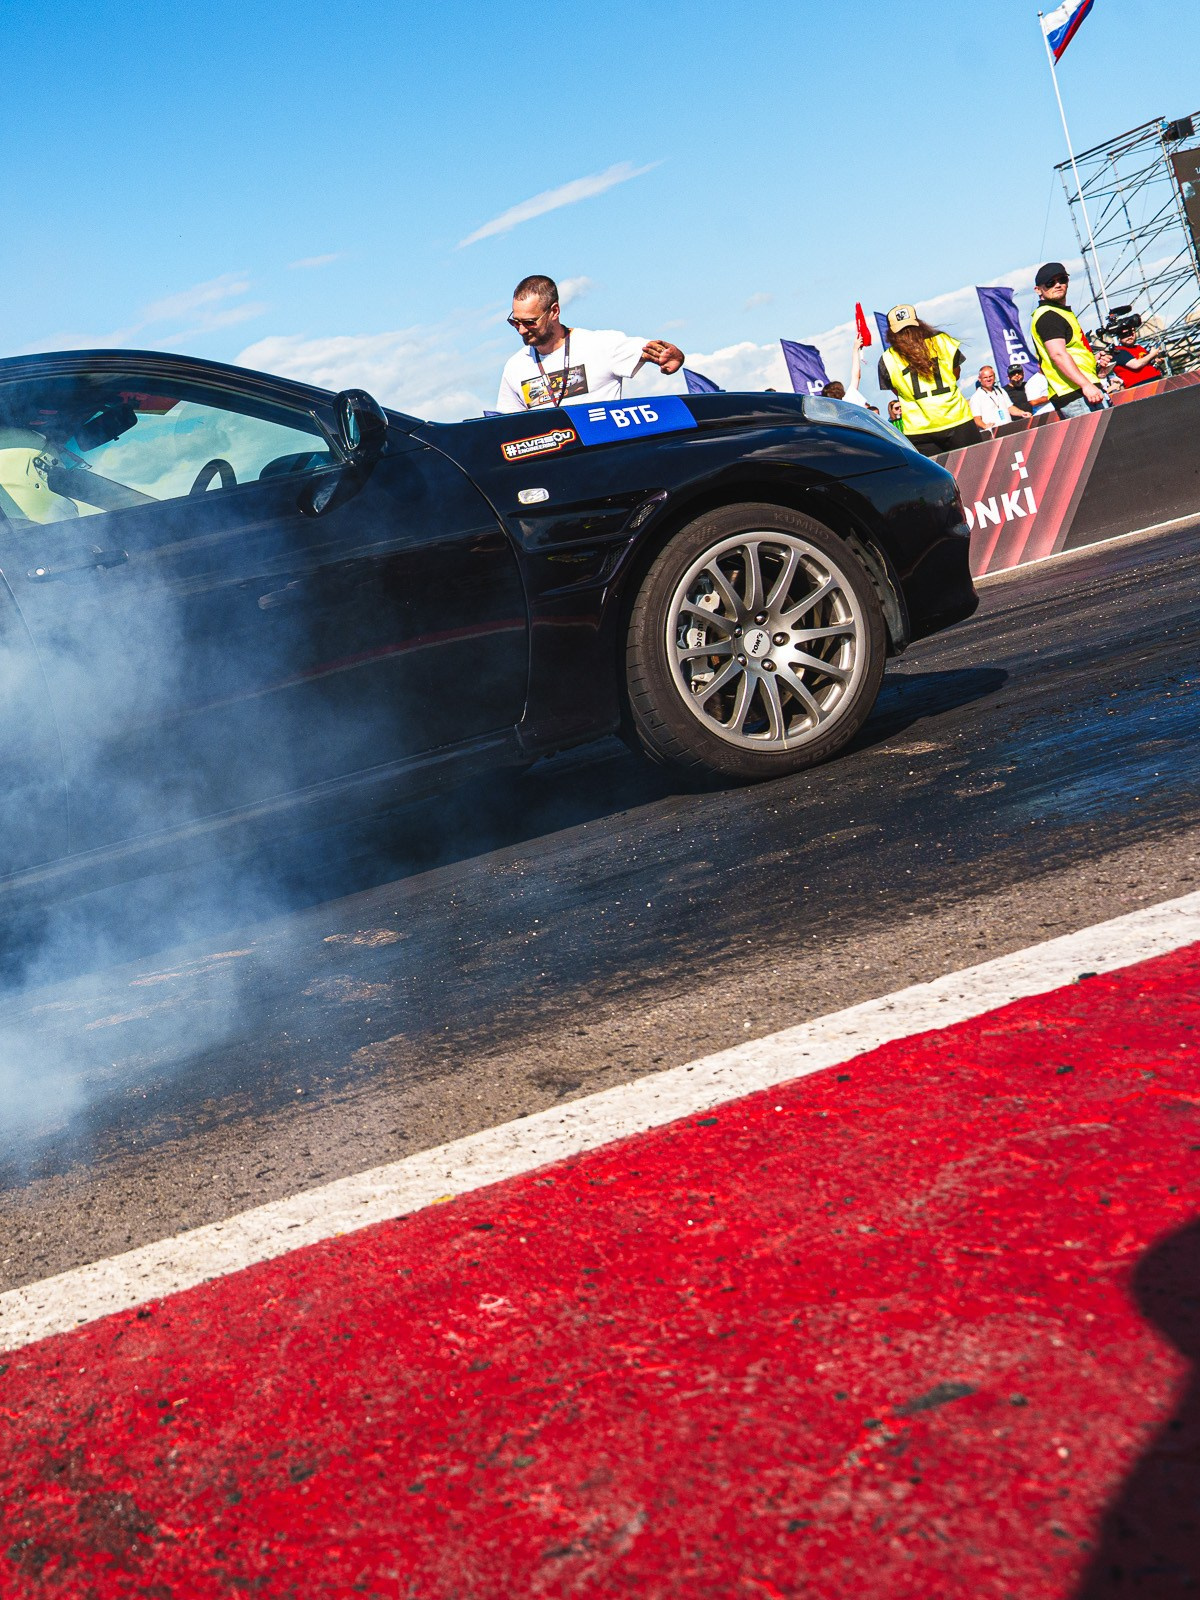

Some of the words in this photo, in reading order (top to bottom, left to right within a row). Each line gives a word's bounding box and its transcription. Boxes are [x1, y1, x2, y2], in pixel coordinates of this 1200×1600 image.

[1003, 329, 1030, 365] ВТБ
[902, 357, 951, 400] 11
[609, 404, 659, 428] ВТБ
[774, 512, 829, 539] KUMHO
